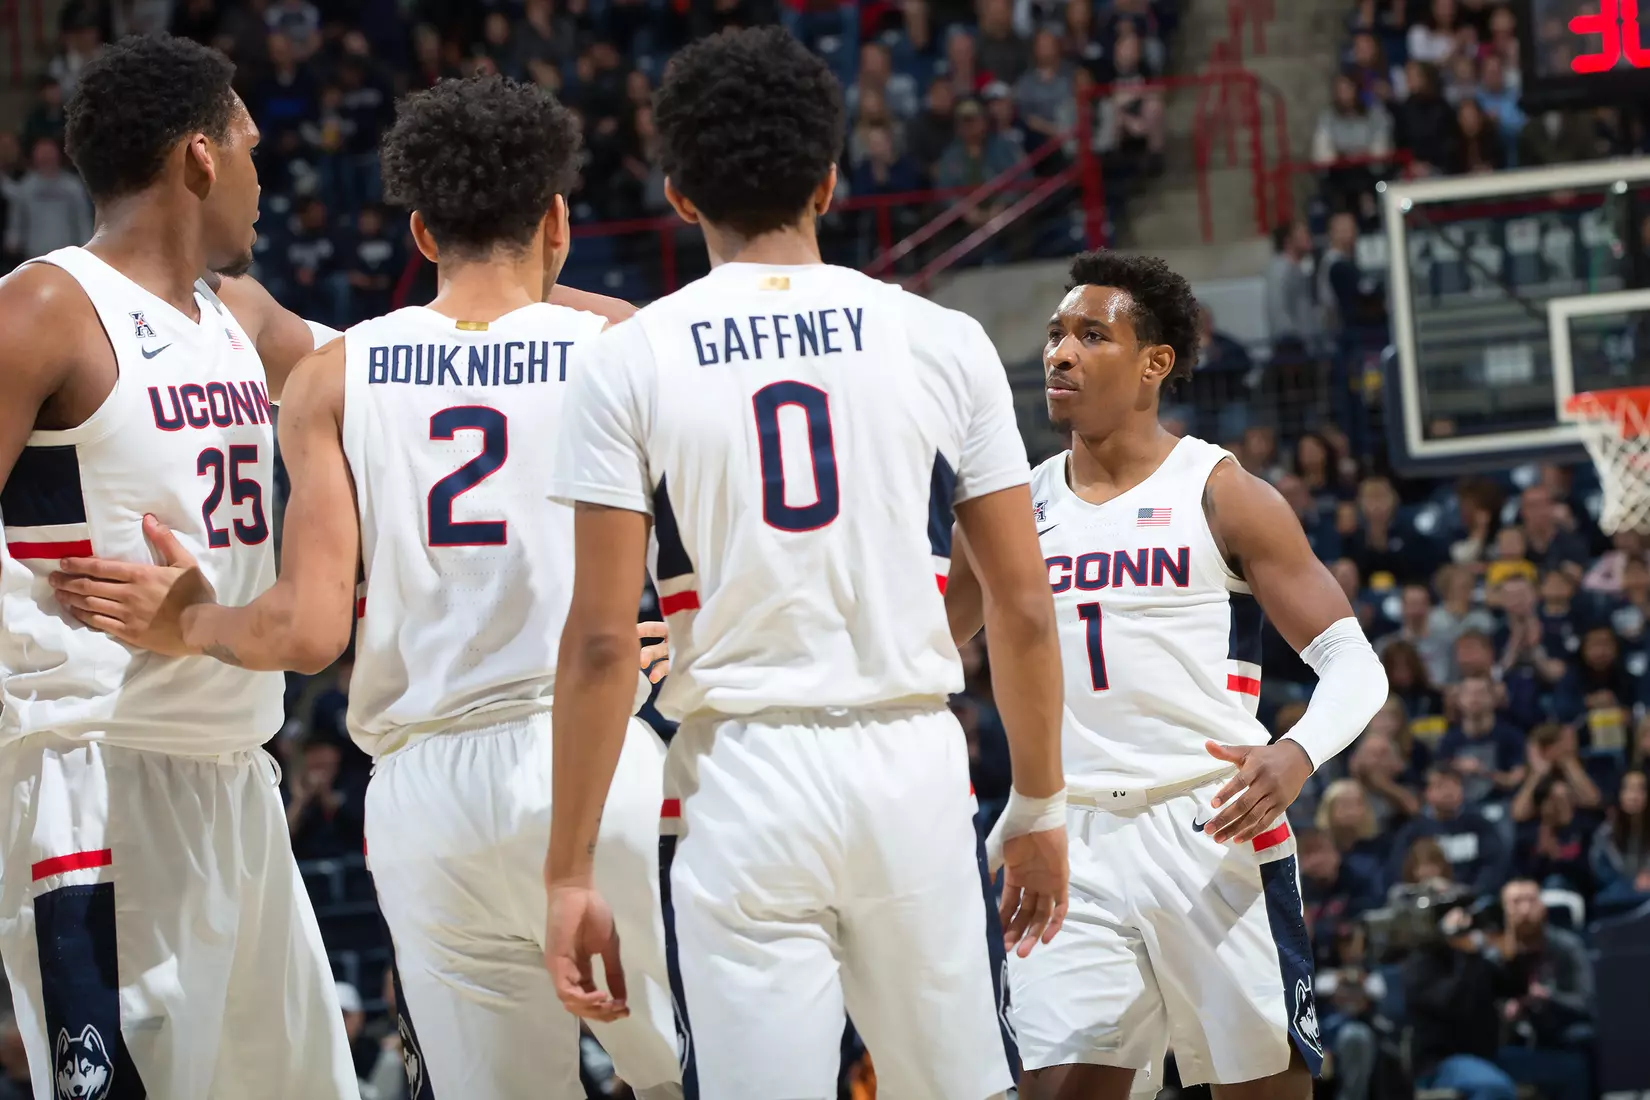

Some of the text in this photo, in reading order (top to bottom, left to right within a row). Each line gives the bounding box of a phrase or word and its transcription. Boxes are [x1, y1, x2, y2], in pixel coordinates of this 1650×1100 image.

[369, 341, 574, 386] BOUKNIGHT
[691, 307, 864, 366] GAFFNEY
[147, 380, 273, 431] UCONN
[196, 444, 269, 548] 25
[428, 404, 508, 547] 2
[752, 379, 839, 532] 0
[1077, 601, 1110, 691] 1
